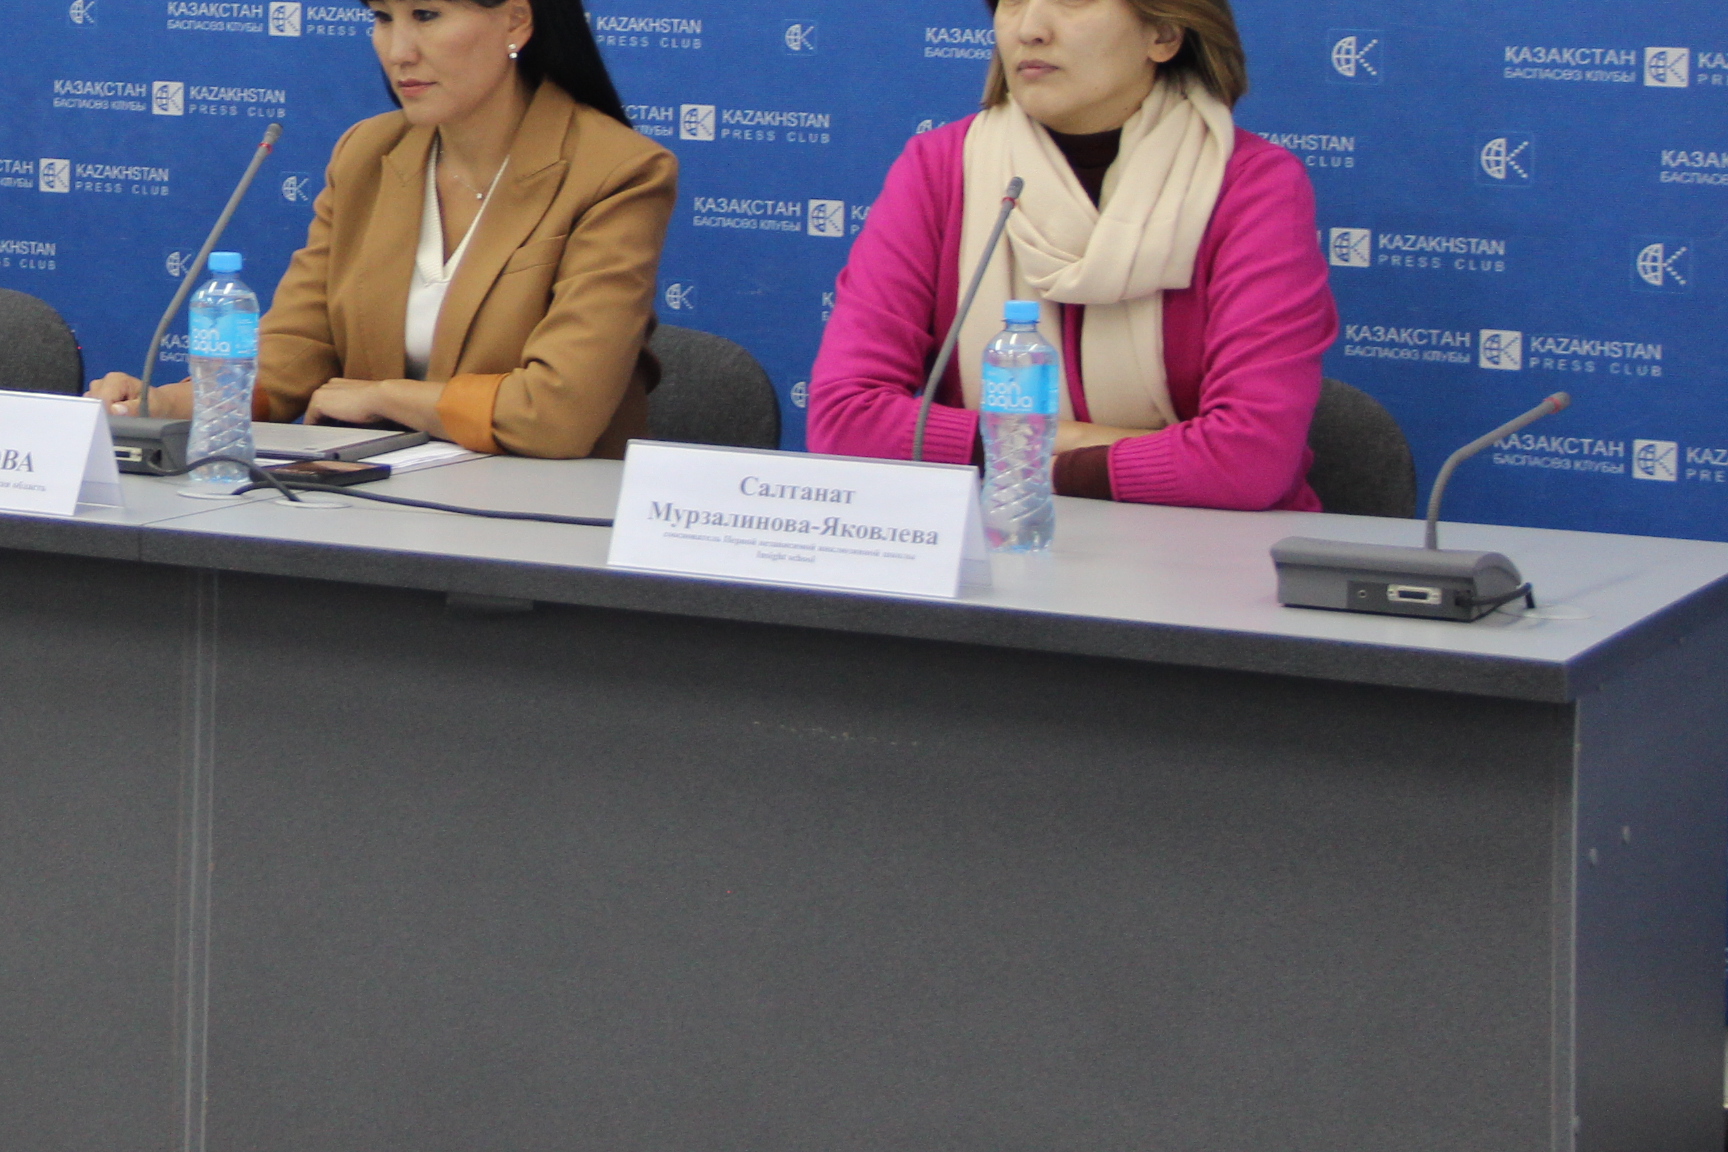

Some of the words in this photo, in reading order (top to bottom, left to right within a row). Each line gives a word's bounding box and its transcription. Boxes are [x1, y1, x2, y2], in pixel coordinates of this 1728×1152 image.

[596, 15, 702, 34] KAZAKHSTAN
[189, 86, 286, 103] KAZAKHSTAN
[722, 109, 831, 128] KAZAKHSTAN
[720, 129, 777, 141] PRESS
[786, 132, 831, 143] CLUB
[75, 164, 169, 182] KAZAKHSTAN
[1378, 234, 1506, 256] KAZAKHSTAN
[1378, 255, 1442, 268] PRESS
[1453, 259, 1506, 272] CLUB
[1530, 336, 1663, 360] KAZAKHSTAN
[1529, 357, 1597, 373] PRESS
[1609, 362, 1662, 376] CLUB
[739, 475, 857, 505] Салтанат
[646, 500, 940, 547] Мурзалинова-Яковлева
